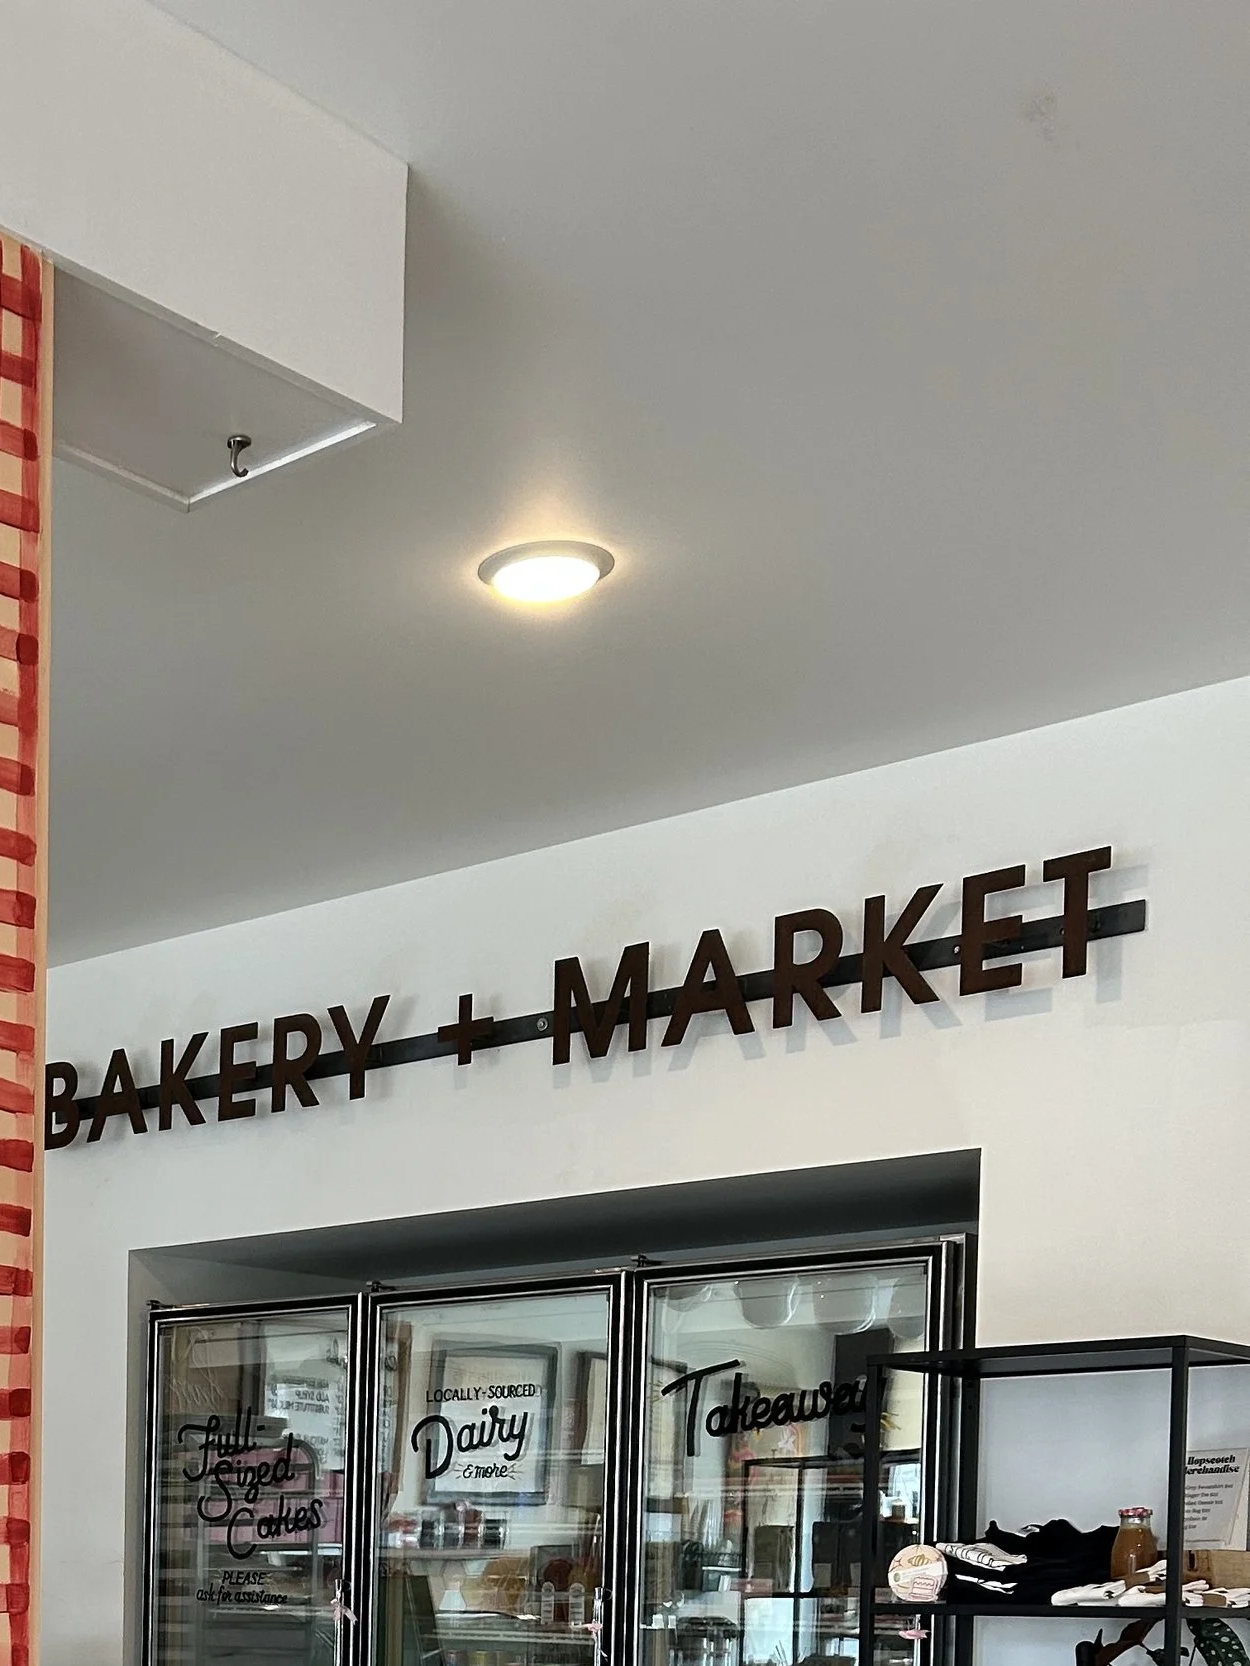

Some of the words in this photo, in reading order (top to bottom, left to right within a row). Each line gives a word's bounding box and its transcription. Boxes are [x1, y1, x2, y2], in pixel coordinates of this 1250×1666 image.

[45, 995, 391, 1150] BAKERY
[552, 846, 1112, 1066] MARKET
[425, 1383, 536, 1403] LOCALLY-SOURCED
[197, 1433, 295, 1522] Sized
[411, 1405, 528, 1480] Dairy
[227, 1495, 324, 1560] Cakes
[222, 1570, 267, 1585] PLEASE
